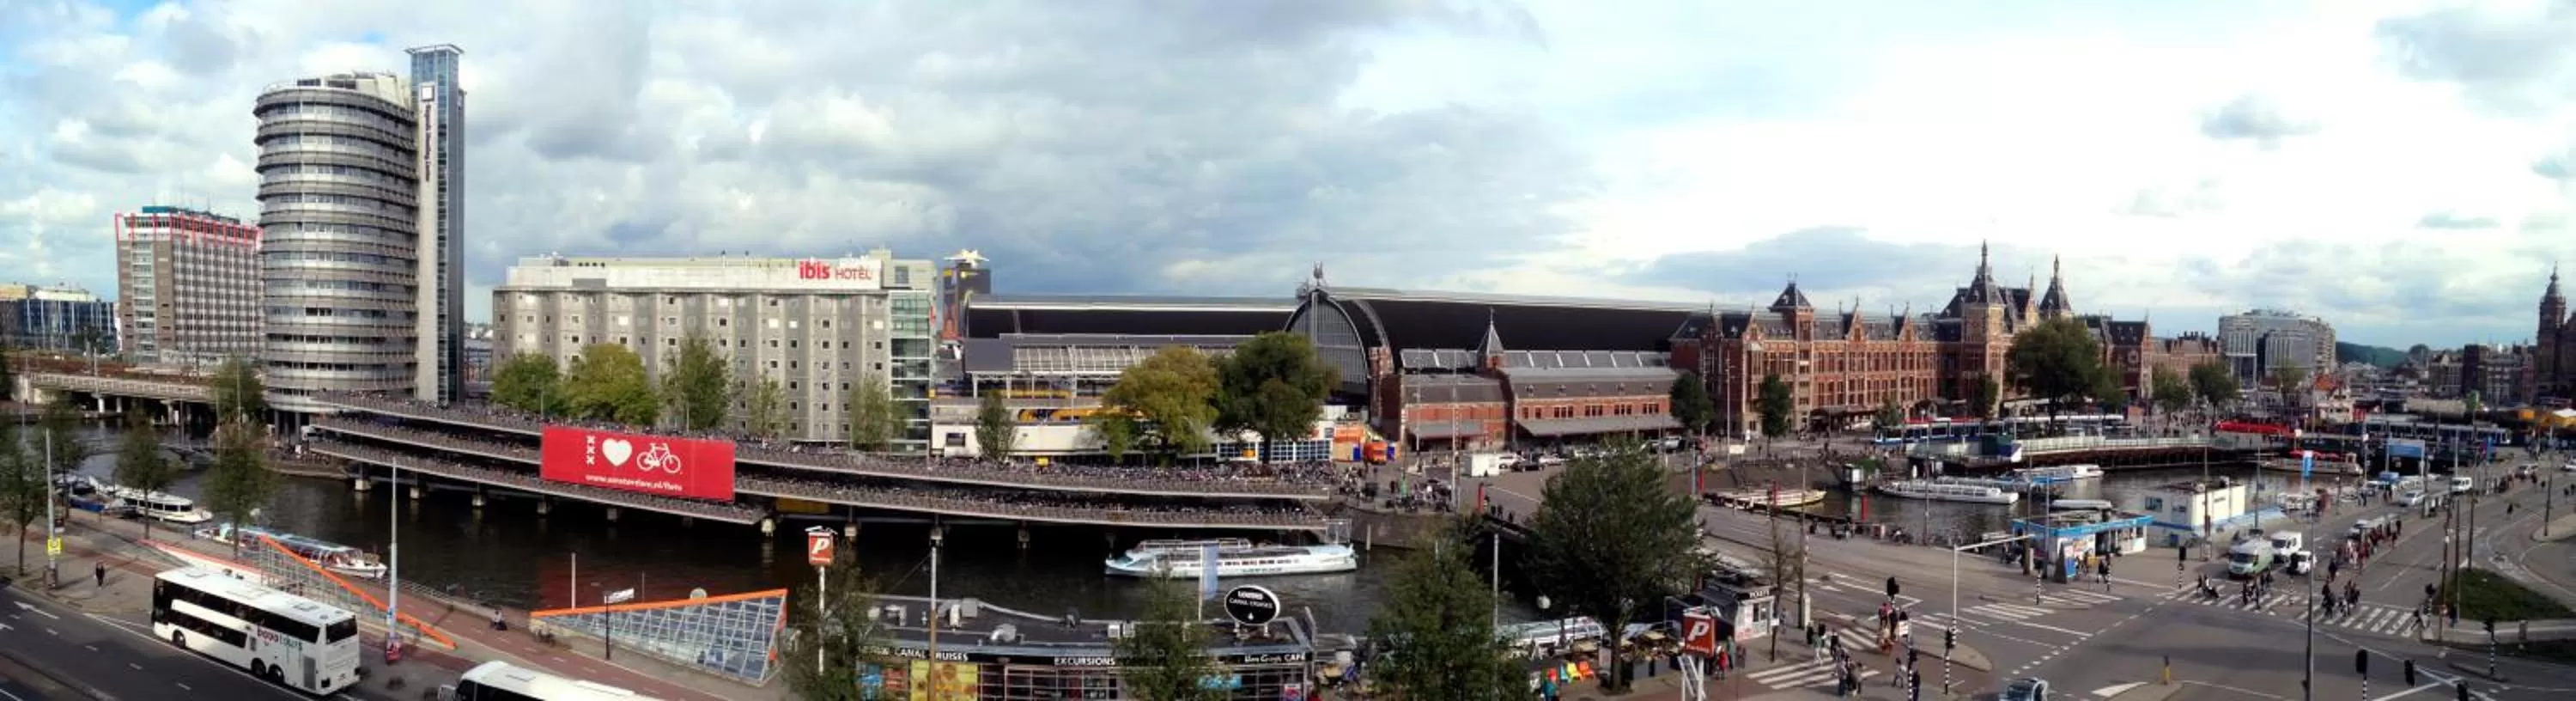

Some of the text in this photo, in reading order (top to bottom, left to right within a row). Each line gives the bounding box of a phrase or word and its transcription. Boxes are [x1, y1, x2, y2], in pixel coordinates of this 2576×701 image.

[799, 260, 829, 279] ibis
[811, 538, 829, 554] P
[1687, 620, 1710, 641] P
[935, 652, 969, 661] RUISES
[1054, 657, 1115, 666] EXCURSIONS
